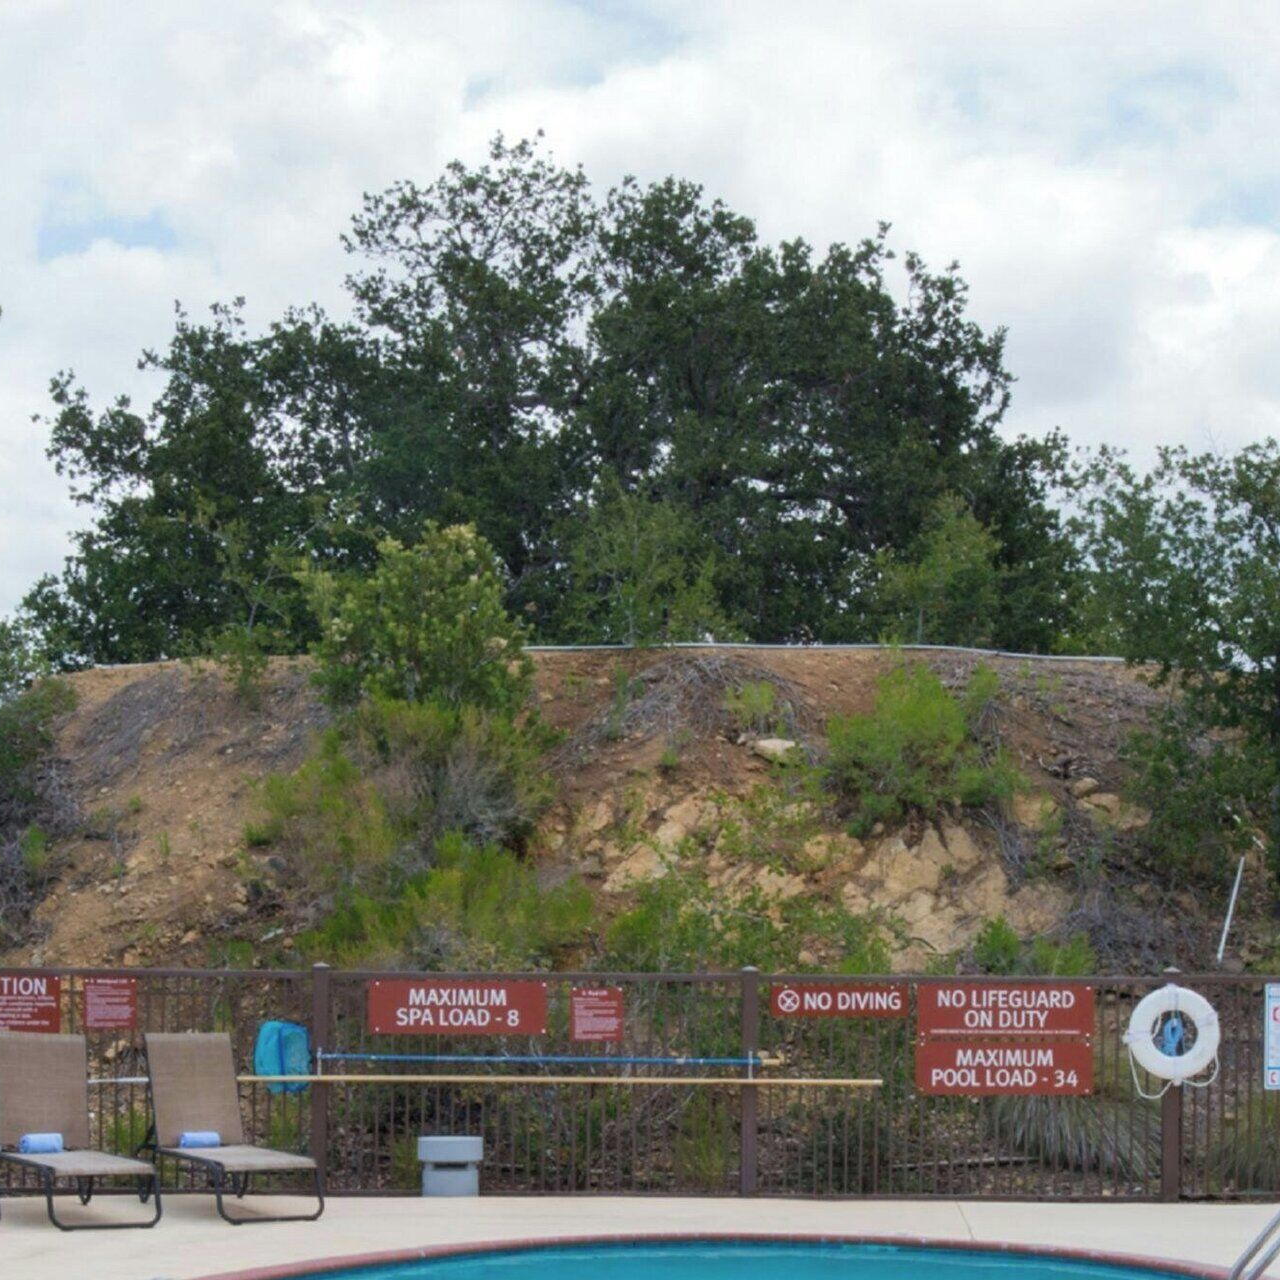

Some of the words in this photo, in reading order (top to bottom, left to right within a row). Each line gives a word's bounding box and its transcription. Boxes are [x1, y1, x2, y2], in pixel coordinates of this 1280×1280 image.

[408, 988, 507, 1006] MAXIMUM
[804, 992, 832, 1010] NO
[837, 992, 902, 1010] DIVING
[937, 990, 966, 1007] NO
[971, 990, 1075, 1009] LIFEGUARD
[396, 1008, 434, 1026] SPA
[439, 1009, 490, 1026] LOAD
[506, 1009, 520, 1027] 8
[964, 1010, 993, 1028] ON
[999, 1010, 1049, 1028] DUTY
[956, 1049, 1054, 1067] MAXIMUM
[931, 1069, 981, 1087] POOL
[985, 1069, 1037, 1087] LOAD
[1053, 1070, 1079, 1088] 34
